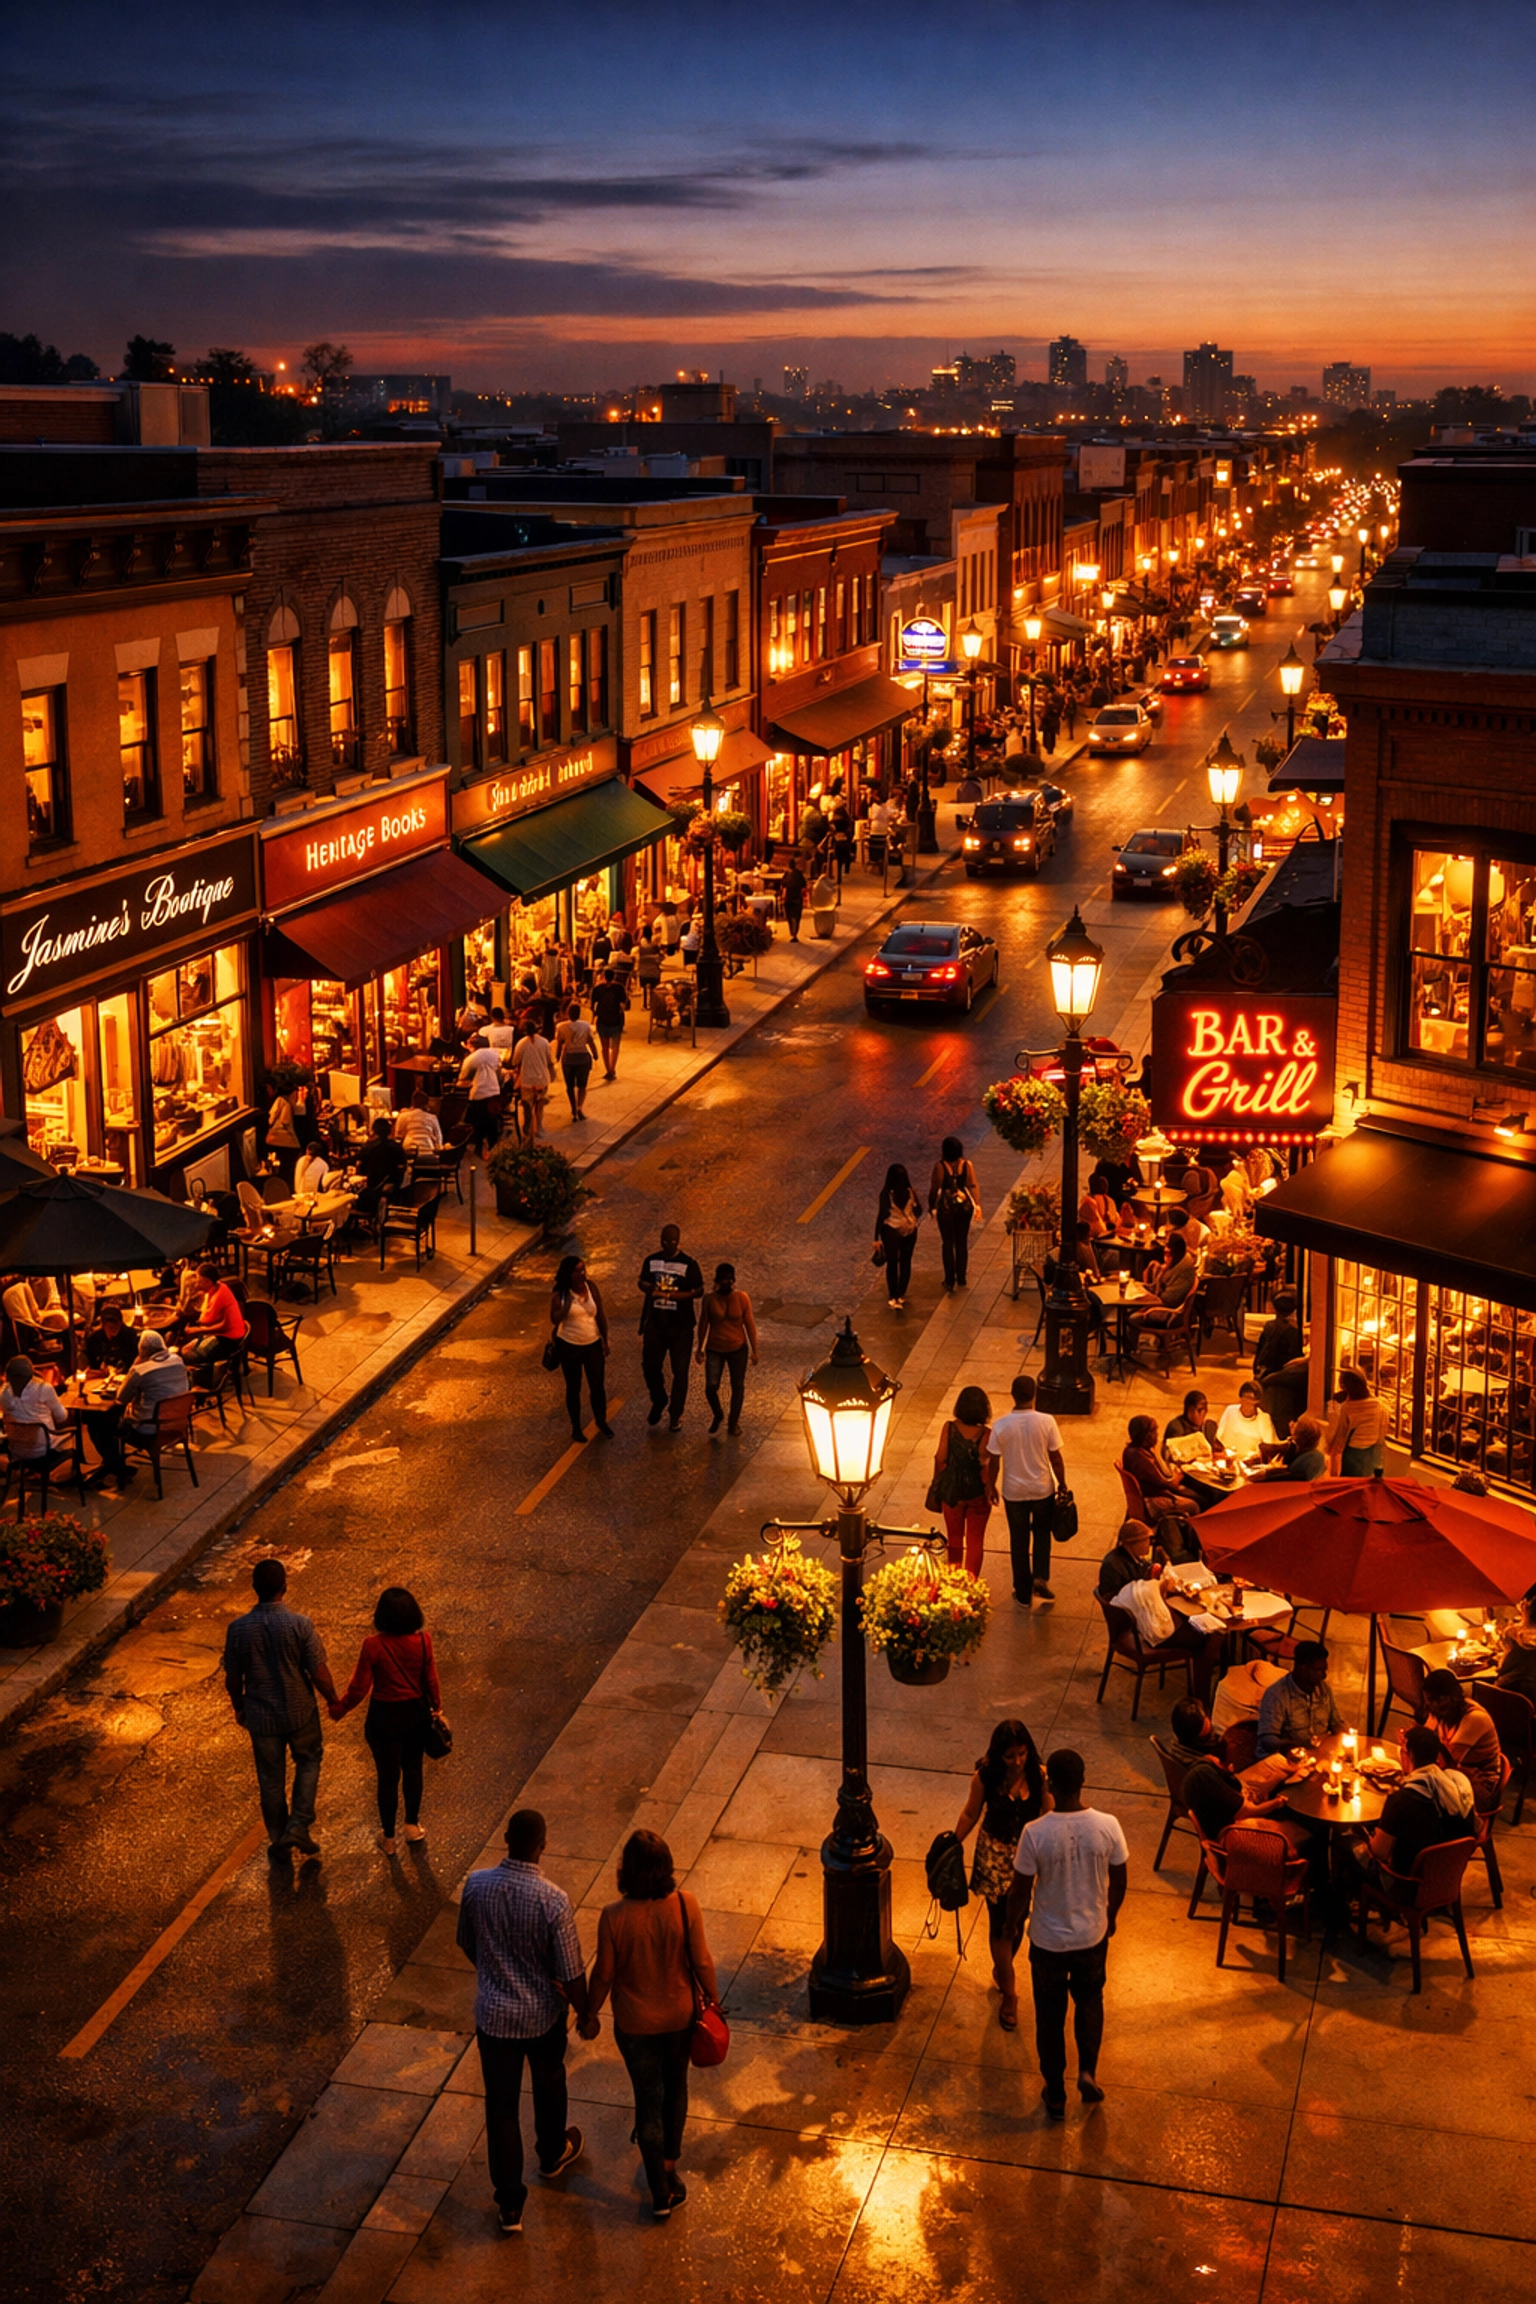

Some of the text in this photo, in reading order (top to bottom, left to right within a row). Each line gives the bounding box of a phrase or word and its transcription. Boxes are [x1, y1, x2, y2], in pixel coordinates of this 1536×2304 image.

[381, 807, 427, 843] BOOKS
[7, 899, 131, 995] Jasmine's
[1187, 1010, 1316, 1057] BAR &
[1182, 1060, 1318, 1118] Grill
